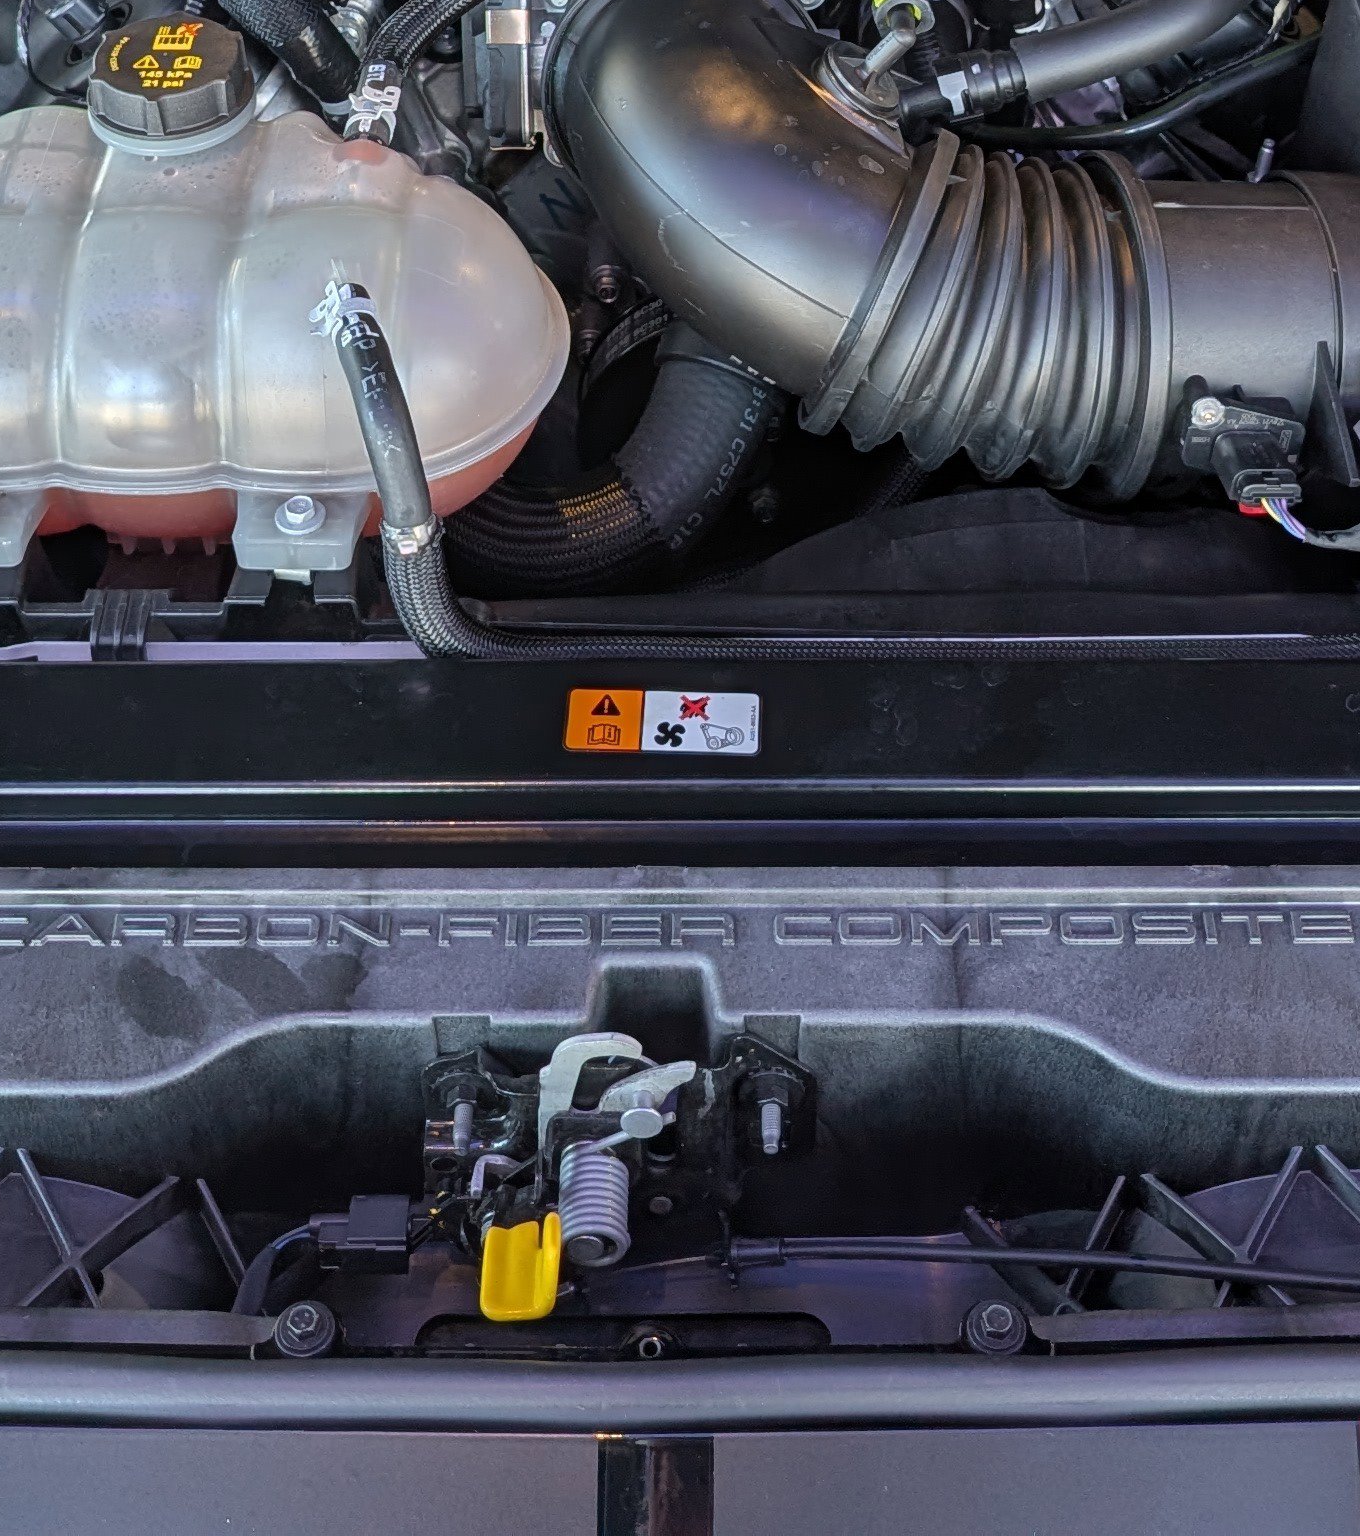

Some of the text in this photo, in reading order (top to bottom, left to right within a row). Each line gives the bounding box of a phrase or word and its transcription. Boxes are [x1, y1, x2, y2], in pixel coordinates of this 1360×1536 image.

[139, 70, 193, 78] 145 kPa
[162, 80, 184, 89] psi
[772, 909, 1357, 948] COMPOSITE
